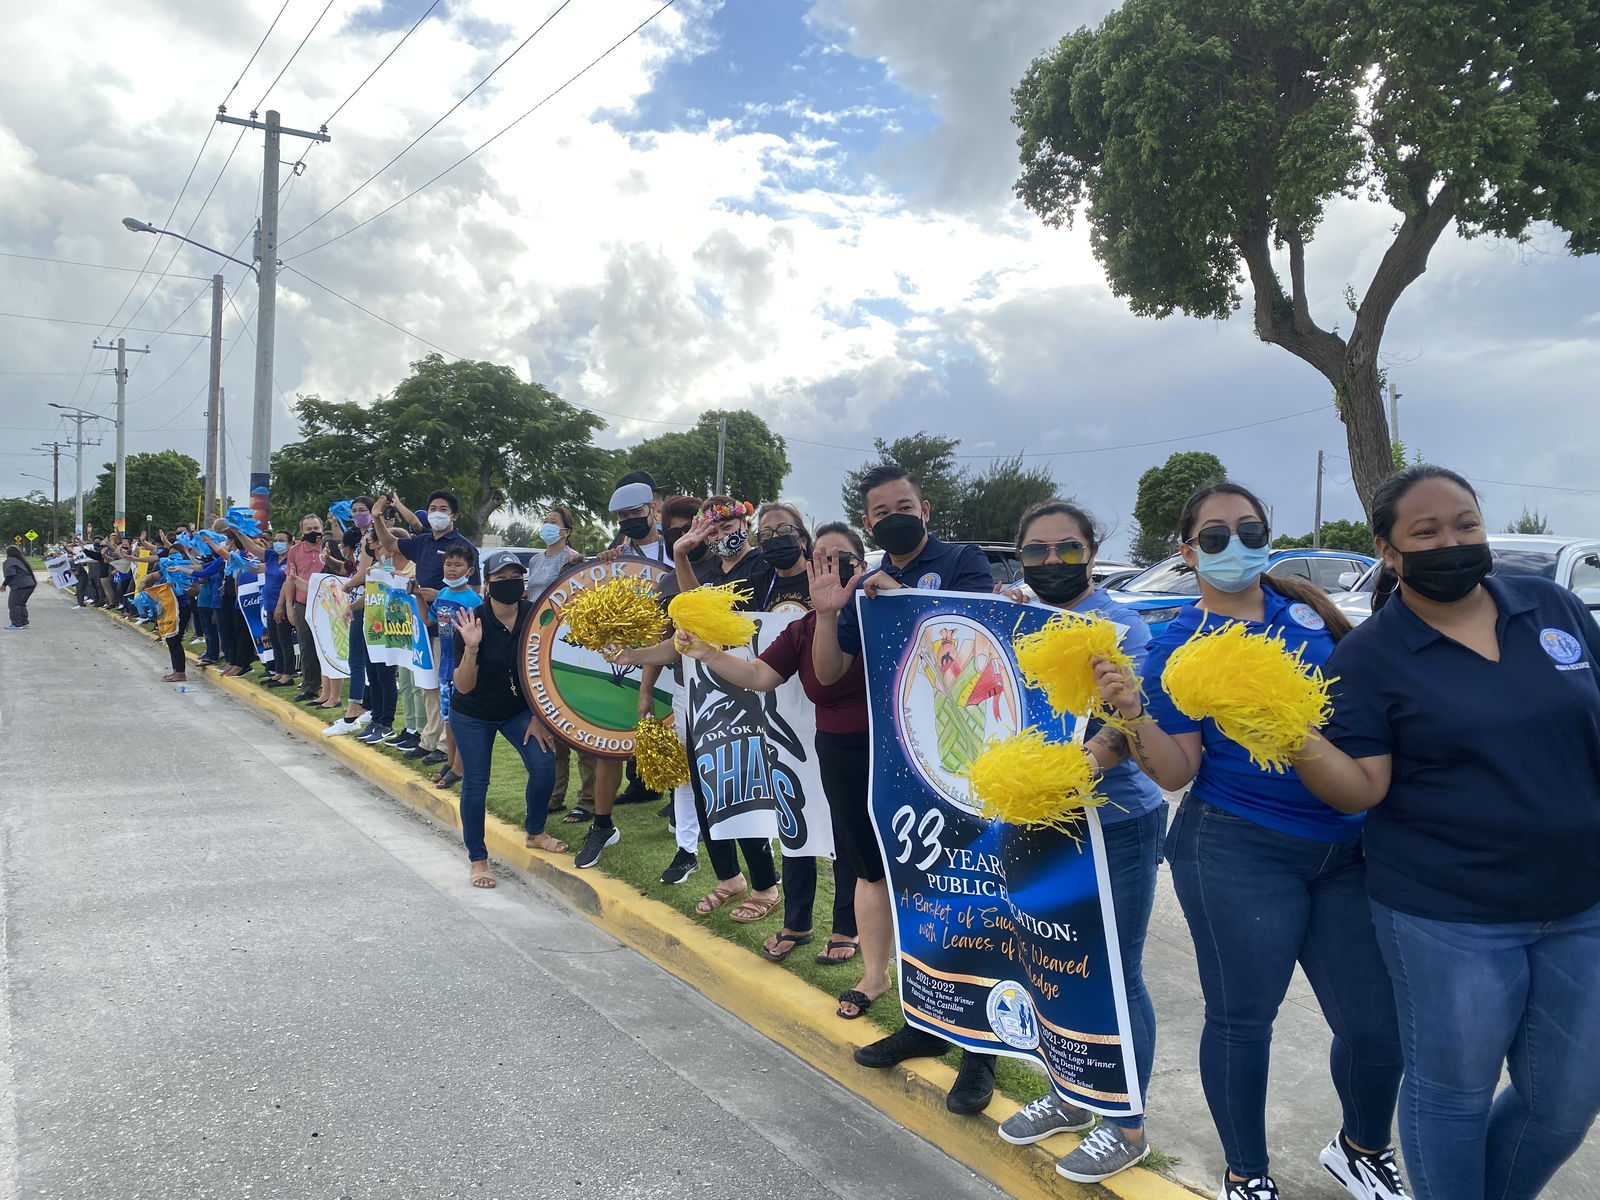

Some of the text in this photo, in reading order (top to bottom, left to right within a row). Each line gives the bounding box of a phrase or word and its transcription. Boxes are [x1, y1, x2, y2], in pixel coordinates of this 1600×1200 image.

[549, 562, 627, 607] DA'OK
[527, 632, 636, 751] CNMI PUBLIC SCHOO
[706, 724, 752, 742] DA'OK
[696, 735, 798, 839] SHAS
[891, 804, 945, 871] 33
[927, 873, 996, 897] PUBLIC
[901, 888, 909, 908] A
[913, 892, 952, 924] Basket
[958, 905, 975, 930] of
[1031, 944, 1090, 978] Weaved
[918, 923, 937, 942] with
[942, 930, 995, 951] Leaves
[1001, 937, 1015, 961] of
[916, 970, 955, 993] 2021-2022
[935, 991, 952, 1001] Theme
[954, 996, 975, 1005] Winner
[1041, 1025, 1088, 1055] 2021-2022
[1060, 1058, 1084, 1073] Diestro
[1062, 1067, 1076, 1077] Grade
[1068, 1053, 1085, 1065] Logo
[1086, 1058, 1117, 1069] Winner
[1076, 1079, 1094, 1090] School
